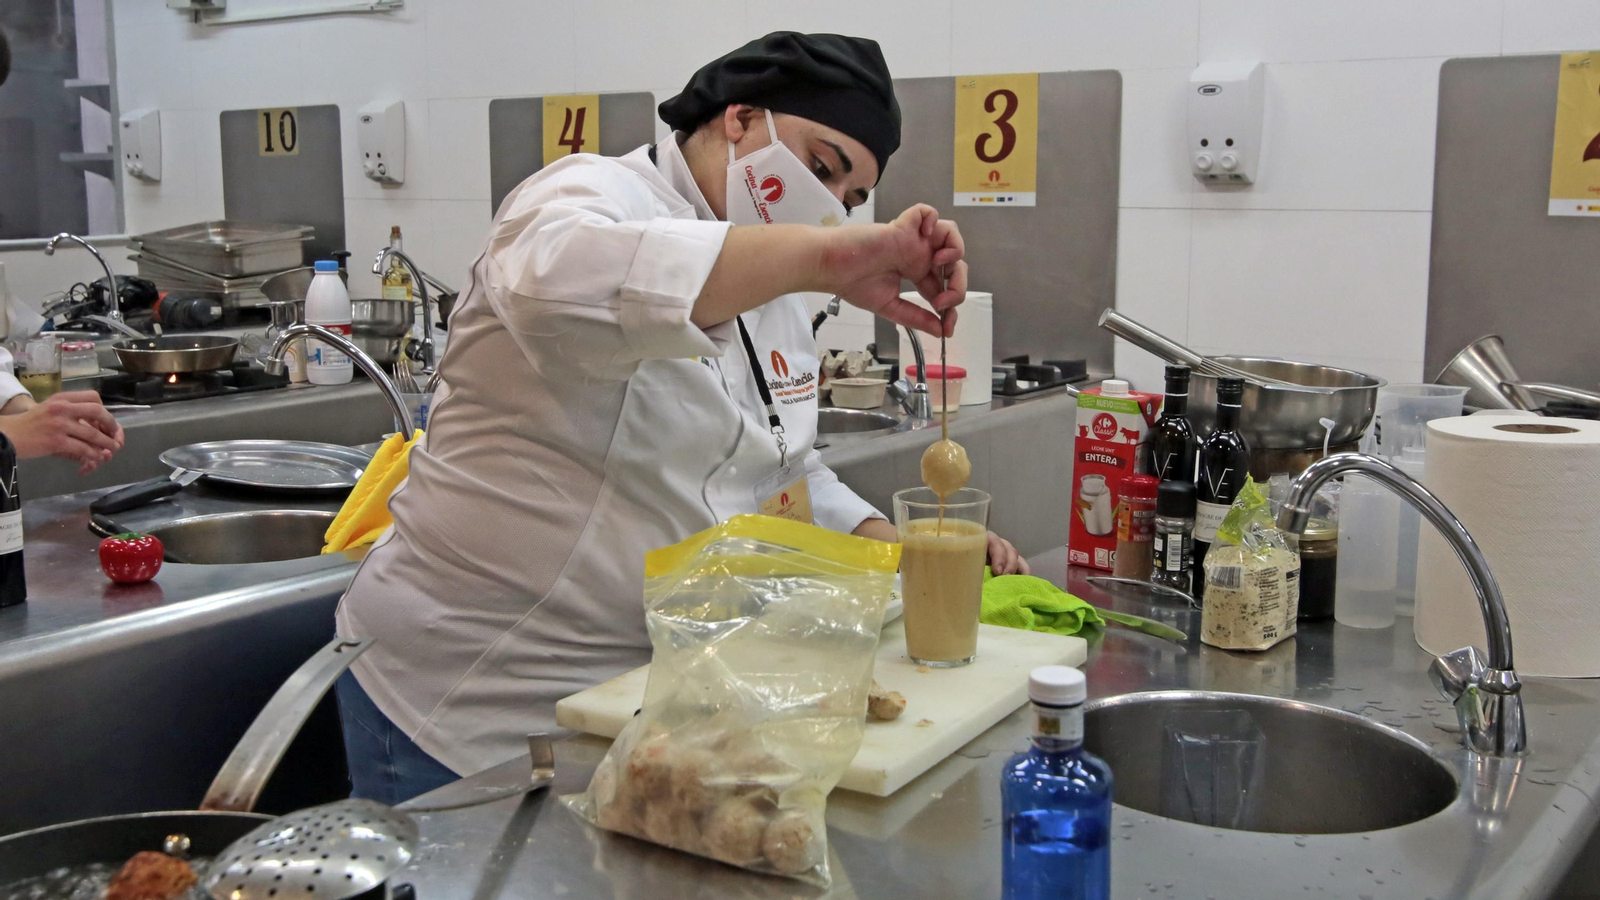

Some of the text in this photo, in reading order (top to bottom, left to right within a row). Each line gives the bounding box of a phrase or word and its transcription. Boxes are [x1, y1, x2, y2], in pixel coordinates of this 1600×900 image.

[262, 110, 297, 152] 10
[557, 106, 587, 154] 4
[974, 89, 1019, 164] 3
[745, 165, 757, 189] Cocina
[759, 202, 773, 224] Esenci
[791, 372, 815, 387] Esencia
[1096, 399, 1113, 408] NUEVO
[1085, 453, 1117, 466] ENTERA
[1206, 465, 1234, 498] VE
